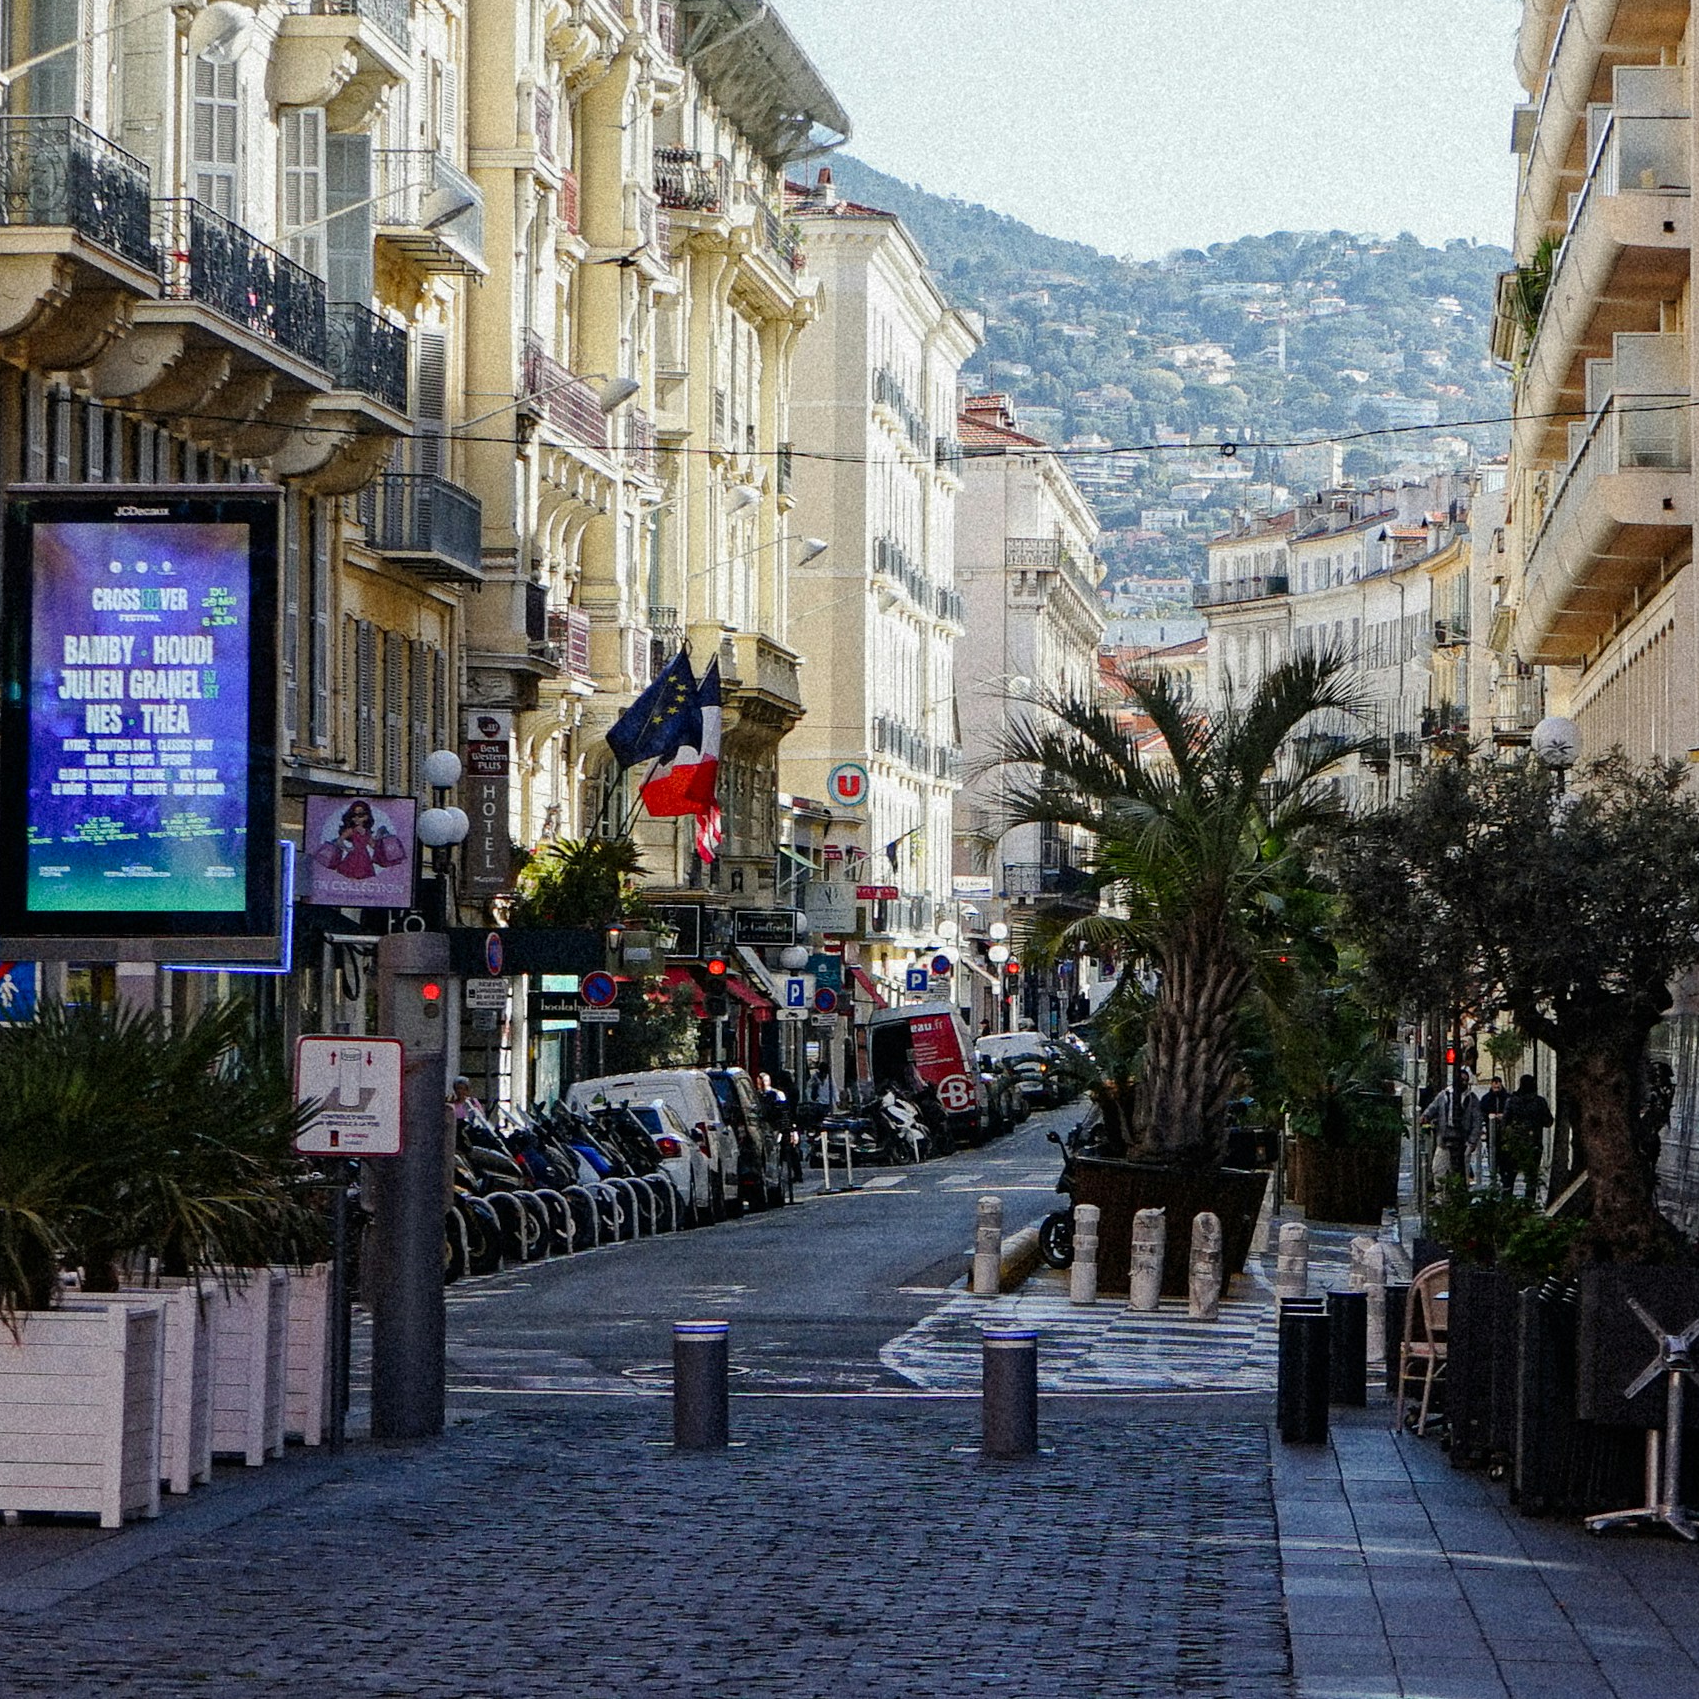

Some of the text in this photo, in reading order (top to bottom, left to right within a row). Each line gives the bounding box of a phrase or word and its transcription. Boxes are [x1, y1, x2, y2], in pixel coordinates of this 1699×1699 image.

[114, 506, 170, 517] JCDecaux
[119, 614, 161, 622] FESTIVAL
[64, 635, 213, 665] BAMBY HOUDI
[58, 669, 201, 699] JULIEN GRANEL
[85, 699, 191, 734] NES THÉA
[480, 744, 499, 753] Best
[471, 752, 508, 762] Western
[477, 761, 502, 771] PLUS
[838, 776, 860, 797] U
[483, 785, 496, 868] HOTEL
[332, 881, 404, 894] COLLECTION
